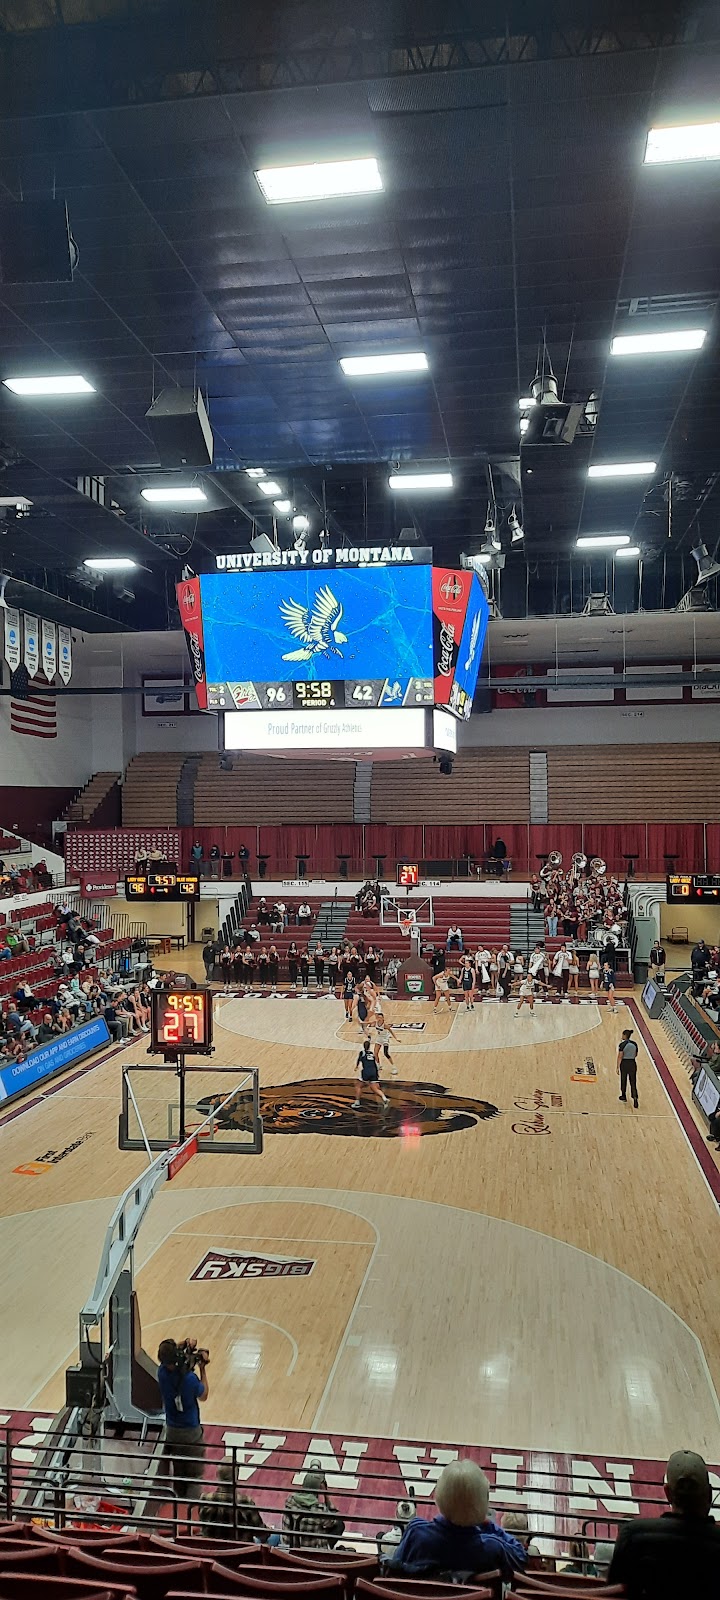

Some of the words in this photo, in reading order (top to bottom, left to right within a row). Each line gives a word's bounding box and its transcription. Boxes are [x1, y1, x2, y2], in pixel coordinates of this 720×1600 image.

[216, 550, 309, 569] UNIVERSITY
[312, 549, 332, 564] OF
[336, 547, 414, 563] MONTANA
[266, 687, 286, 702] 96
[296, 682, 331, 698] 9:58
[352, 685, 373, 700] 42
[219, 698, 225, 706] 0
[415, 693, 422, 702] 0
[267, 723, 289, 735] Proud
[291, 722, 314, 735] Partner
[315, 722, 323, 733] of
[155, 876, 174, 885] 9:57
[400, 872, 416, 883] 27
[132, 883, 144, 893] 96
[183, 883, 194, 893] 42
[682, 885, 689, 896] 0
[168, 996, 202, 1011] 9:57
[164, 1013, 198, 1040] 27
[12, 1056, 40, 1076] DOWNLOAD
[40, 1051, 50, 1061] OUR
[49, 1047, 58, 1057] APP
[59, 1042, 68, 1053] AND
[68, 1036, 80, 1049] EARN
[78, 1024, 100, 1040] DISCOUNTS
[36, 1065, 45, 1074] ON
[45, 1060, 55, 1069] GAS
[54, 1055, 64, 1065] AND
[64, 1042, 87, 1059] GROCERIES
[34, 1150, 59, 1162] First
